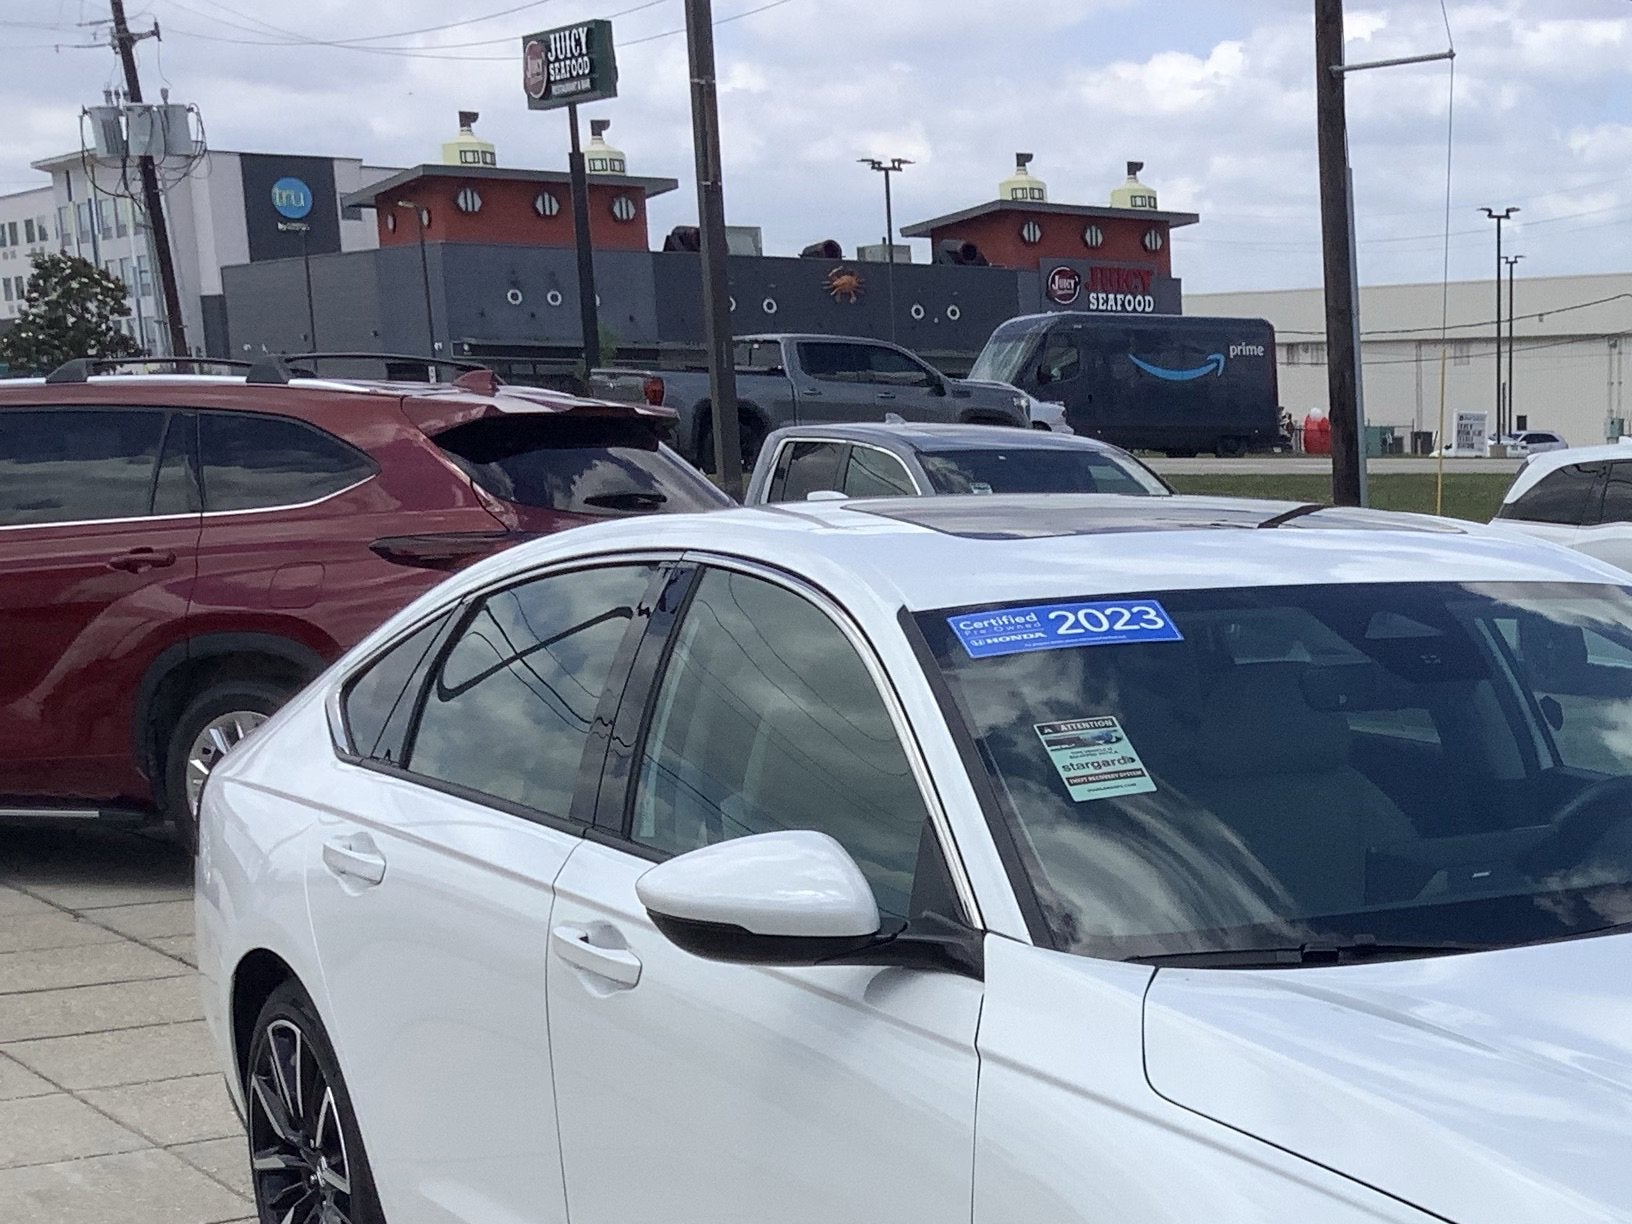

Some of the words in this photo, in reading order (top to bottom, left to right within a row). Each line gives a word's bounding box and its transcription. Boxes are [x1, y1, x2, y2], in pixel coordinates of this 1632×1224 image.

[548, 27, 588, 62] JUICY
[549, 56, 591, 81] SEAFOOD
[272, 186, 305, 207] tru
[1084, 266, 1155, 294] JUICY
[1089, 292, 1154, 313] SEAFOOD
[1229, 341, 1265, 359] prime
[959, 611, 1038, 631] Certified
[964, 629, 987, 637] Pre
[993, 621, 1041, 633] Owned
[1048, 606, 1164, 636] 2023
[986, 631, 1048, 645] HONDA
[1060, 719, 1113, 732] ATTENTION
[1061, 755, 1126, 773] stargard
